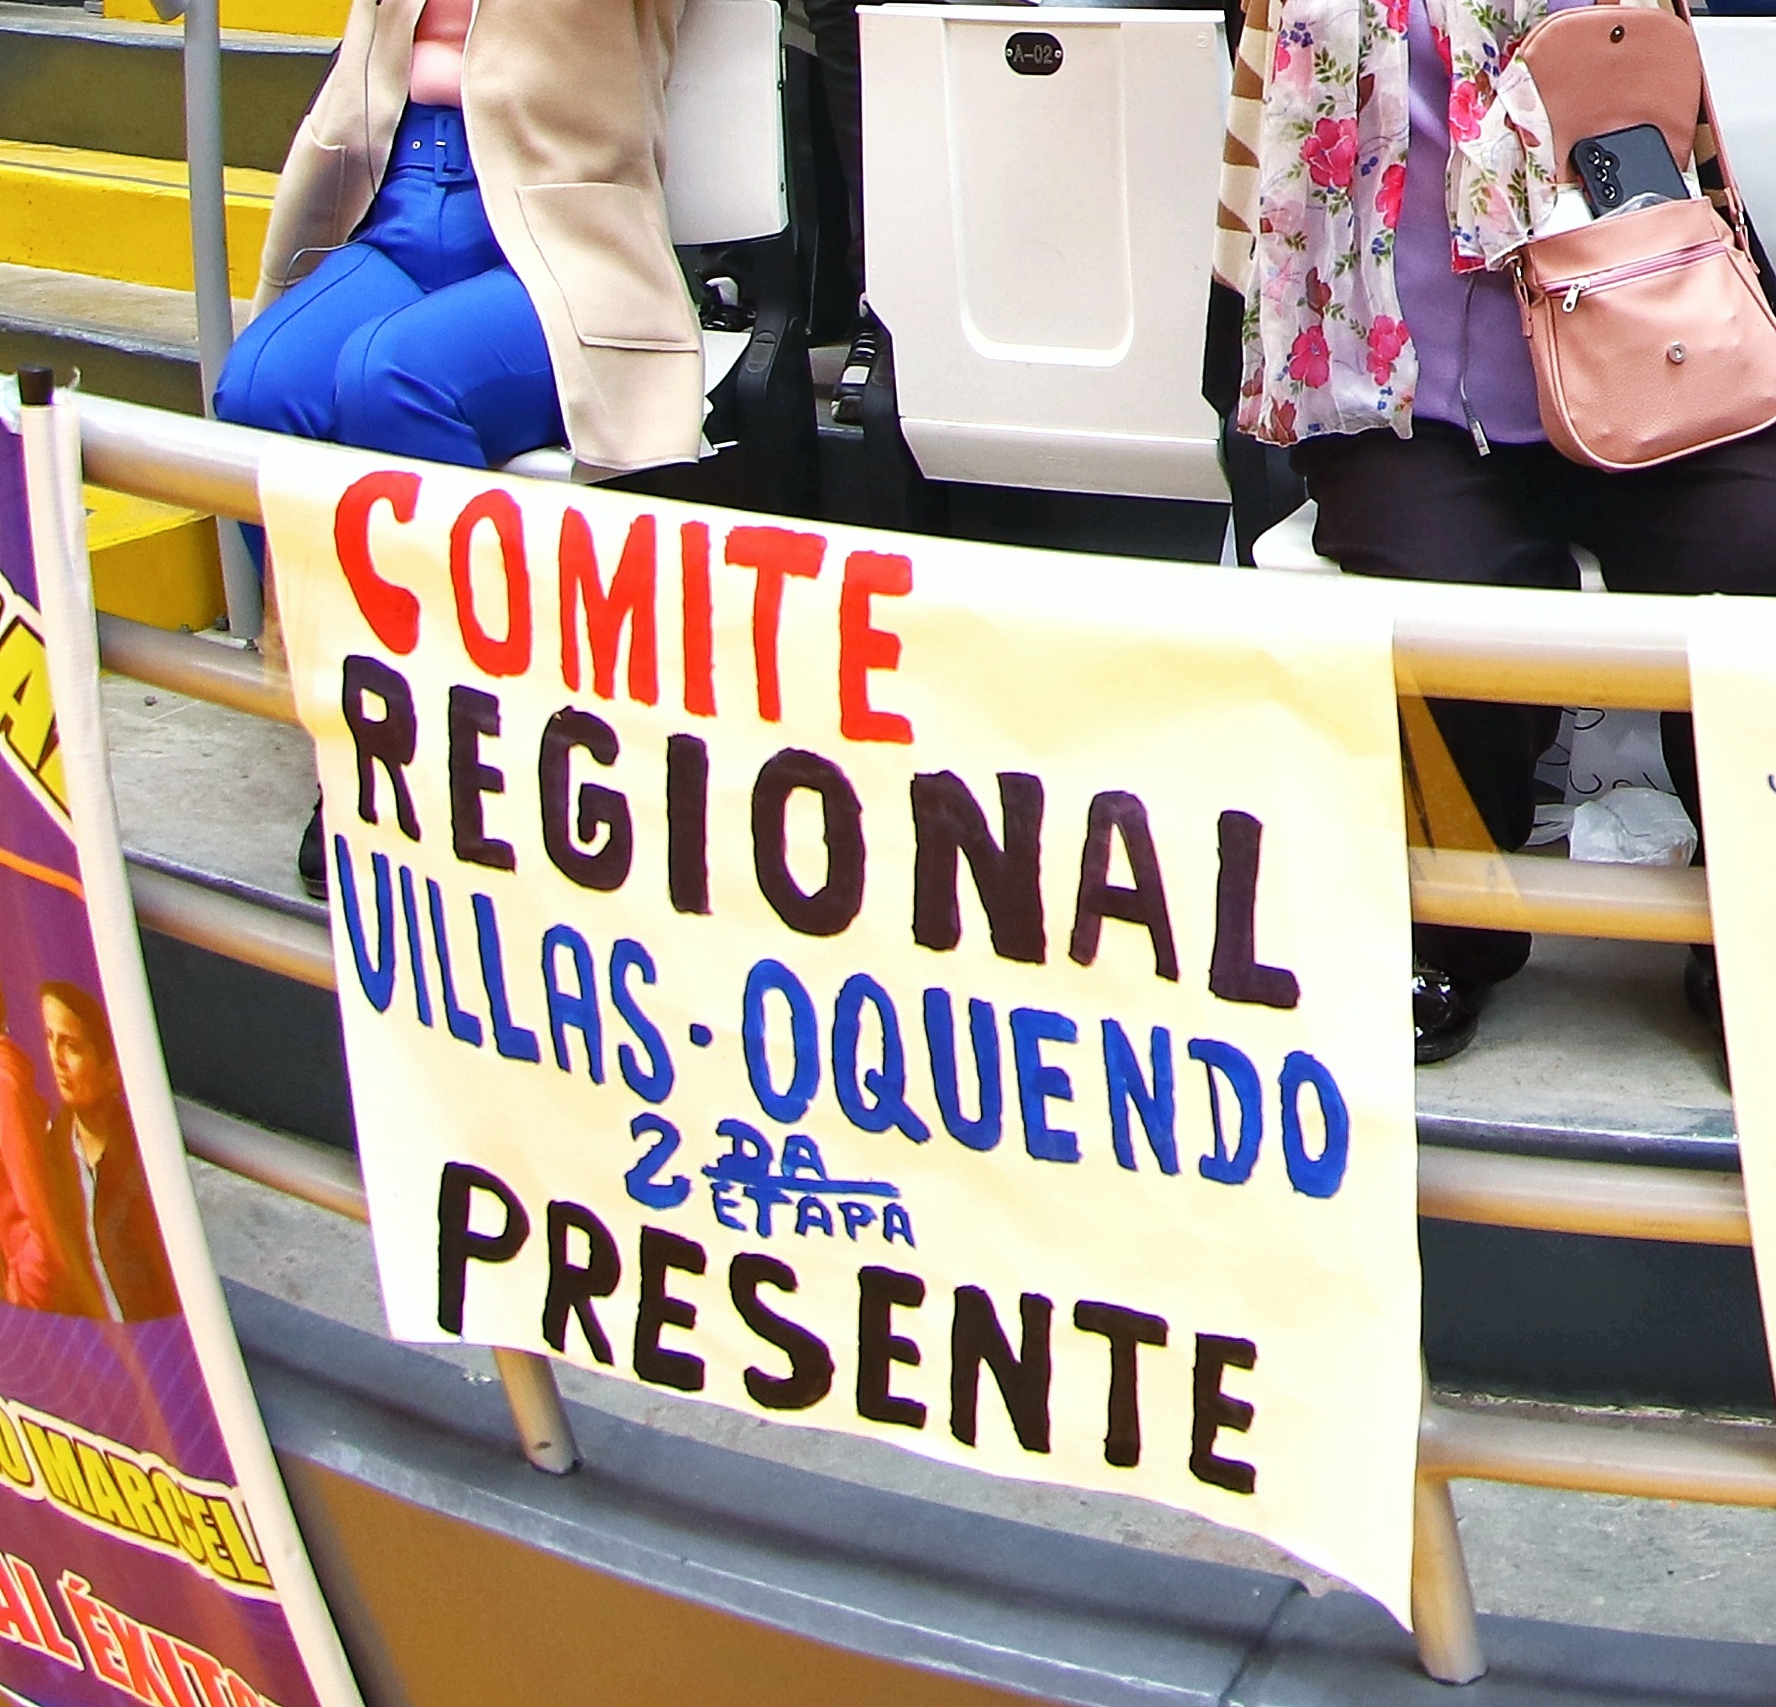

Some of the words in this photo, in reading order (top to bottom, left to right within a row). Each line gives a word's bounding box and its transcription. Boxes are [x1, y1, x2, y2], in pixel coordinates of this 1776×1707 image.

[1013, 43, 1054, 65] A-02
[334, 469, 915, 745] COMITE
[342, 654, 1302, 1009] REGIONAL
[625, 1113, 692, 1211] 2
[711, 1178, 916, 1248] ETAPA
[436, 1161, 1259, 1494] PRESENTE
